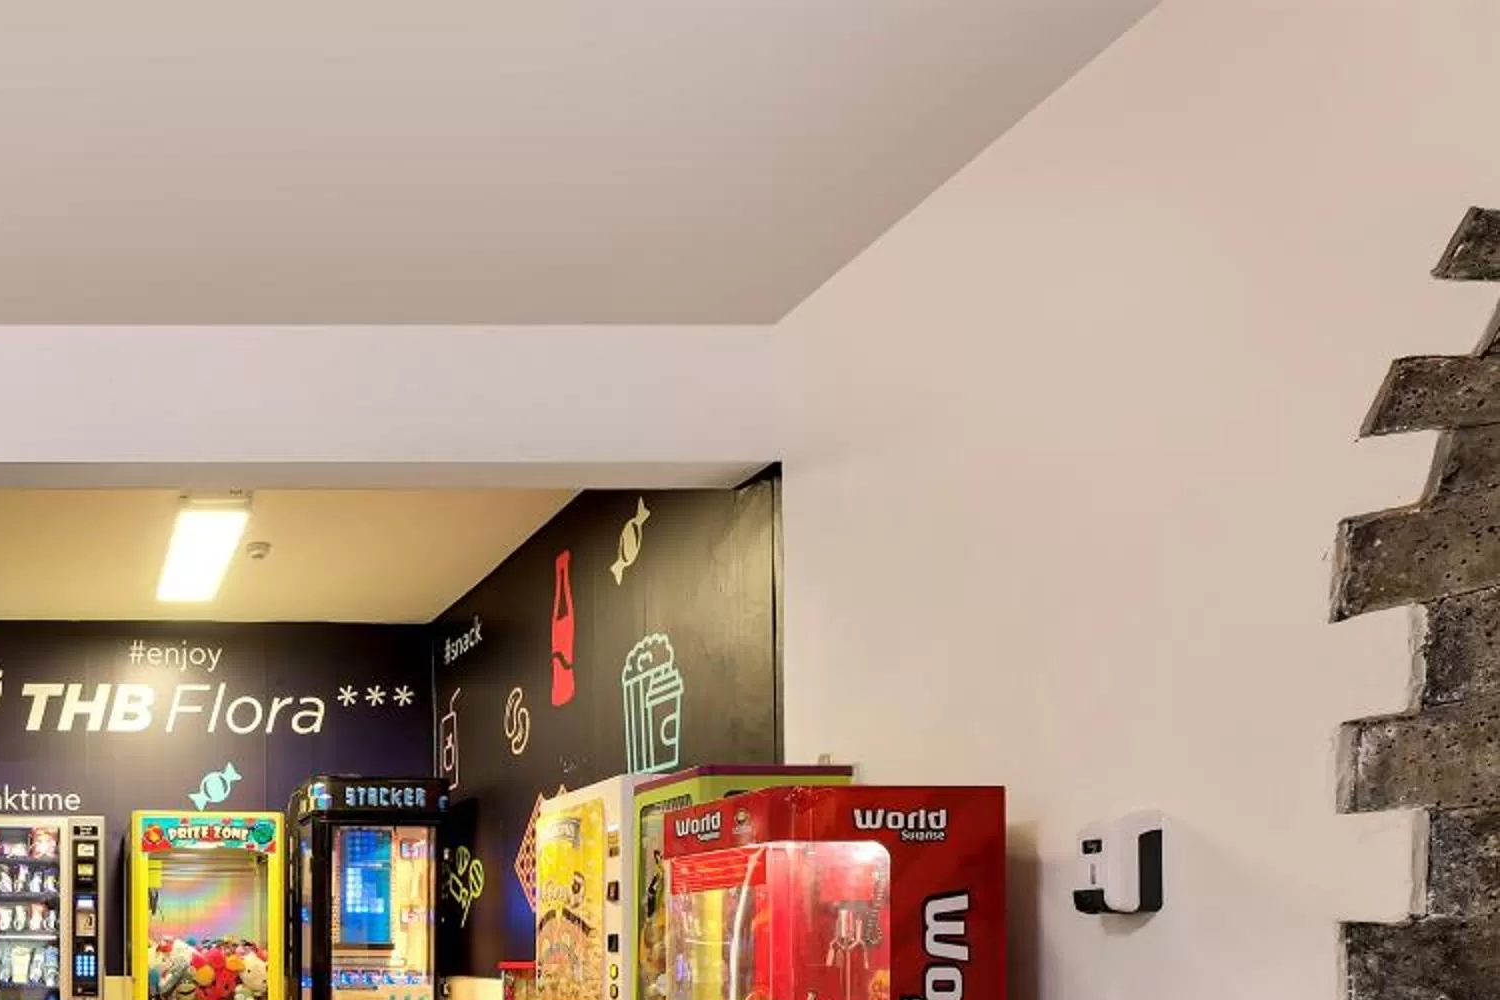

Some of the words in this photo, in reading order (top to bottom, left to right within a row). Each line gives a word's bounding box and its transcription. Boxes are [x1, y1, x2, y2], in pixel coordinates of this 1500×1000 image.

[444, 615, 483, 666] #snack
[129, 640, 223, 671] #enjoy
[21, 682, 155, 732] THB
[166, 682, 326, 735] Flora
[345, 787, 427, 807] STACKER
[675, 810, 721, 837] World
[853, 808, 947, 829] World
[901, 829, 945, 841] Surprise
